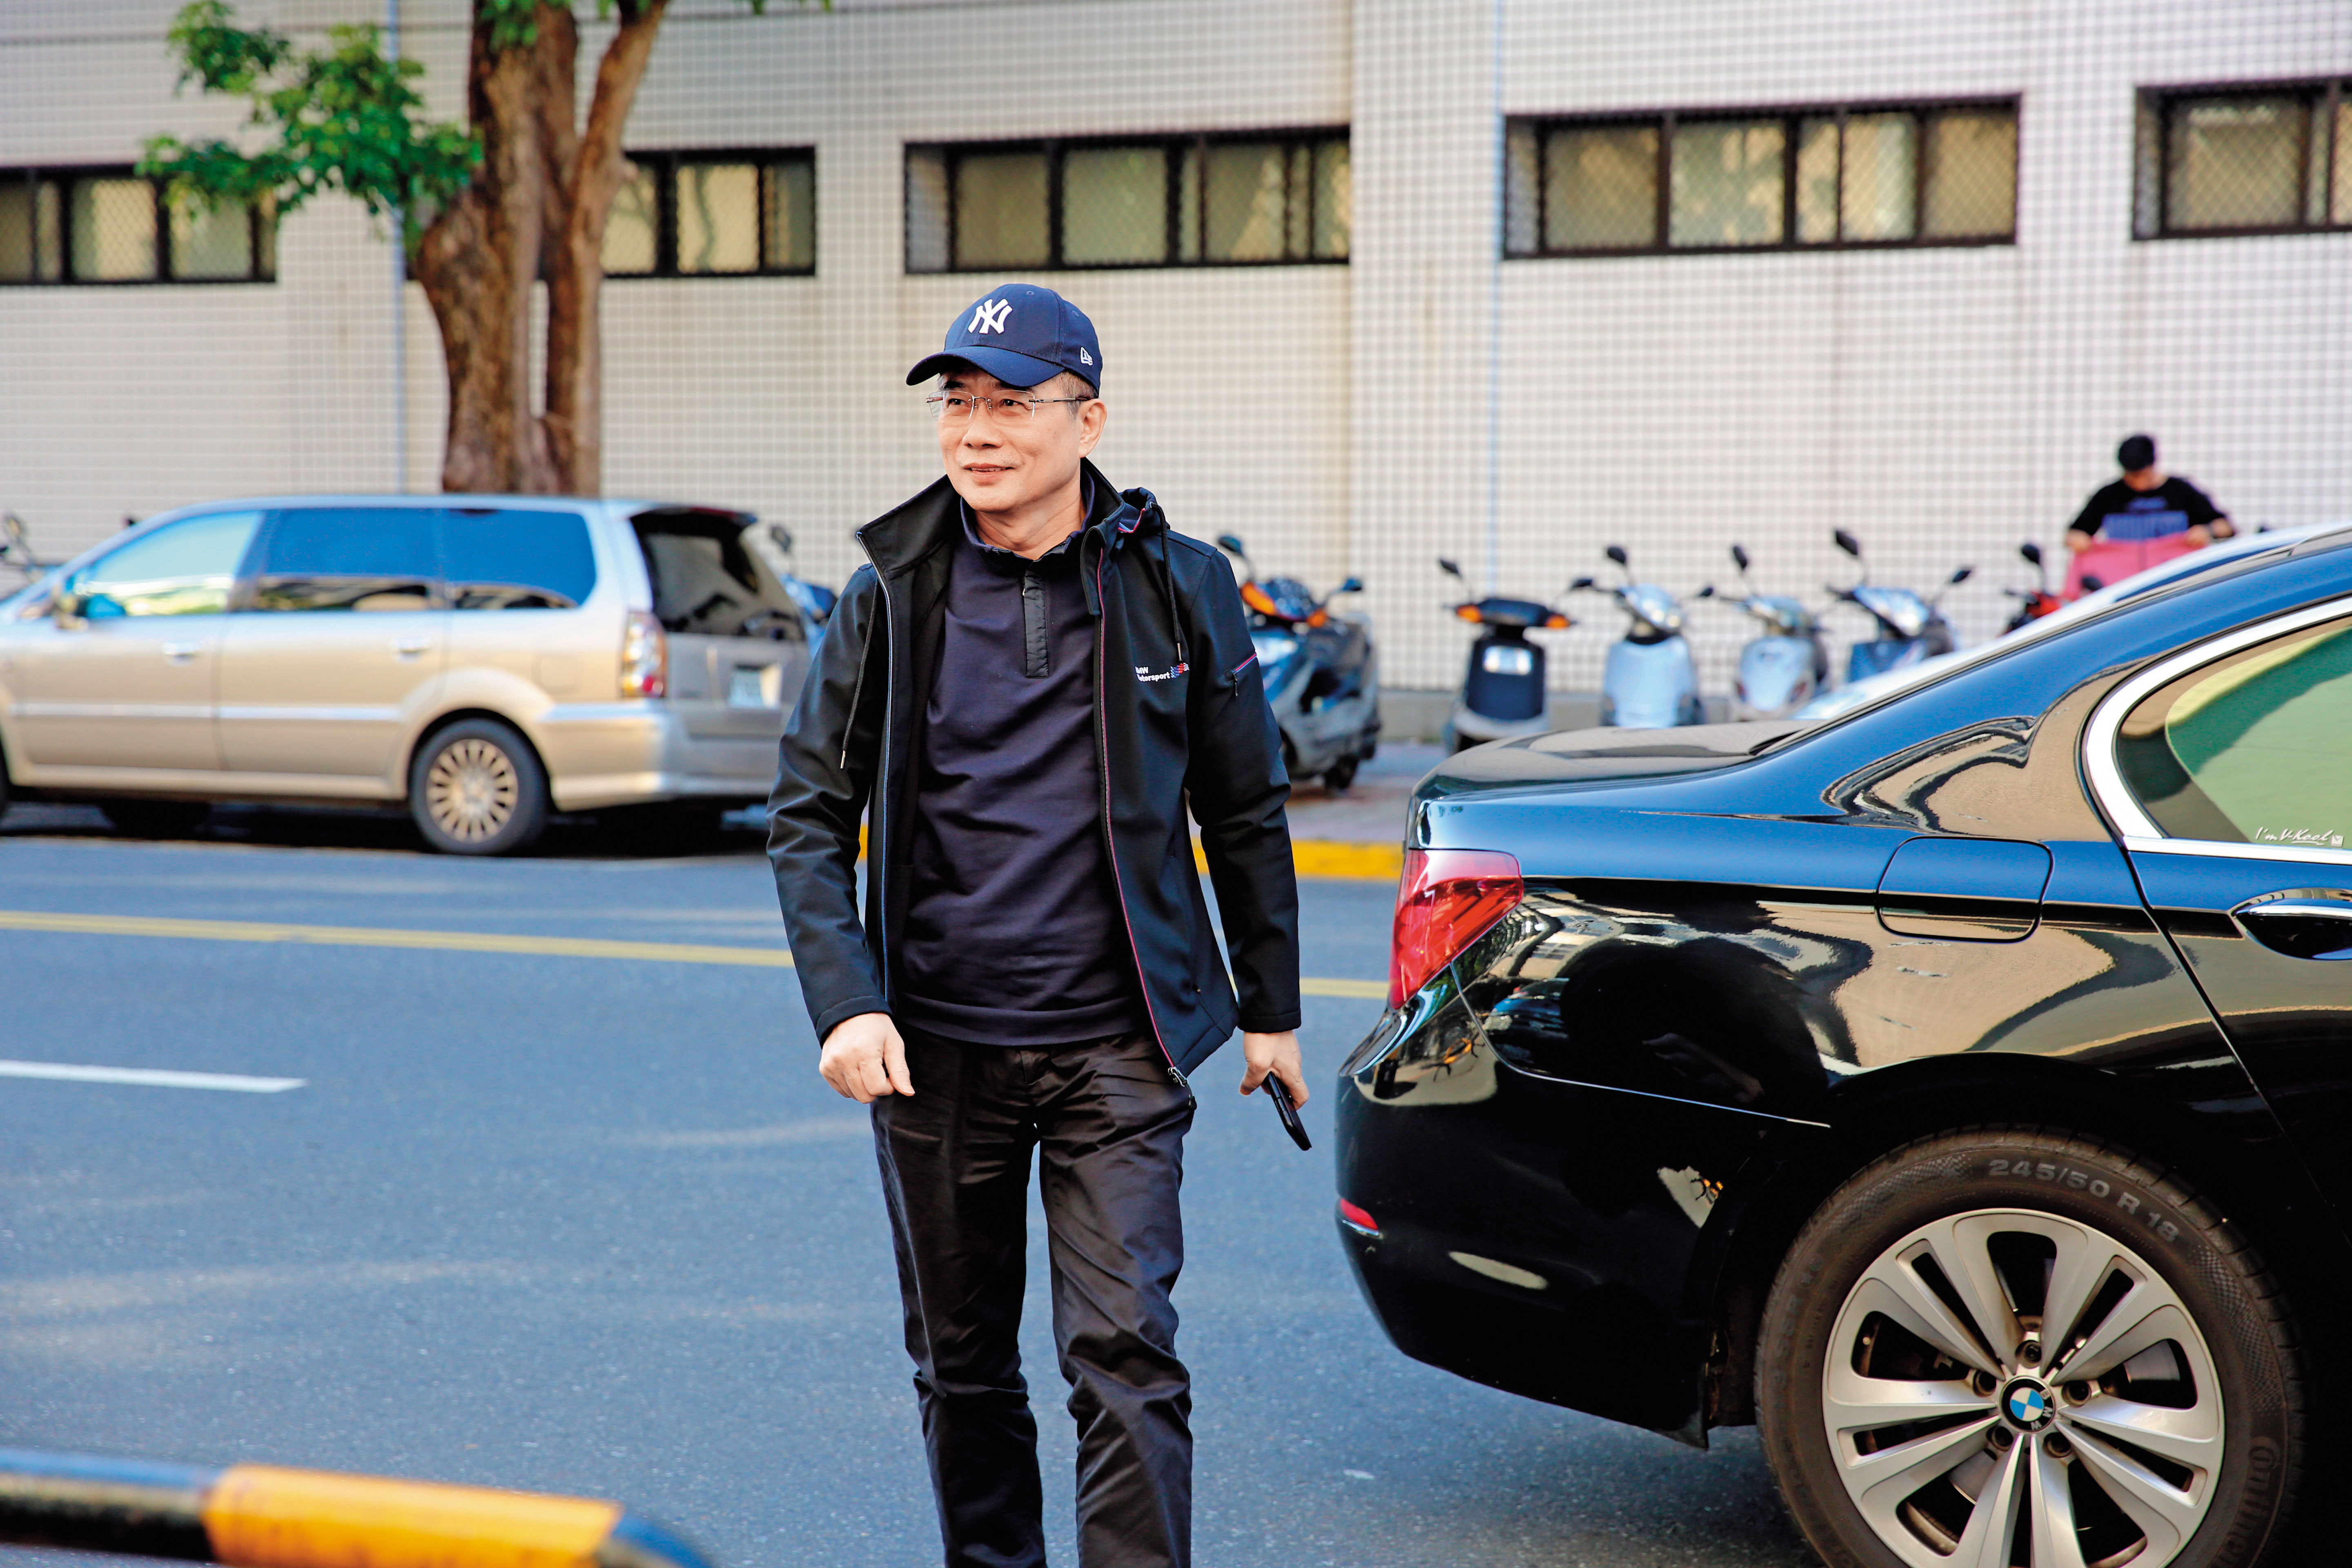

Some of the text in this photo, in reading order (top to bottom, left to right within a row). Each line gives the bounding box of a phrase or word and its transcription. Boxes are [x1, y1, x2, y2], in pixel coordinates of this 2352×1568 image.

[968, 298, 1013, 334] NY
[2255, 826, 2278, 841] I'm
[1989, 1159, 2110, 1198] 245/50
[2116, 1192, 2141, 1215] R
[2147, 1212, 2179, 1243] 18
[2030, 1389, 2054, 1430] BMW
